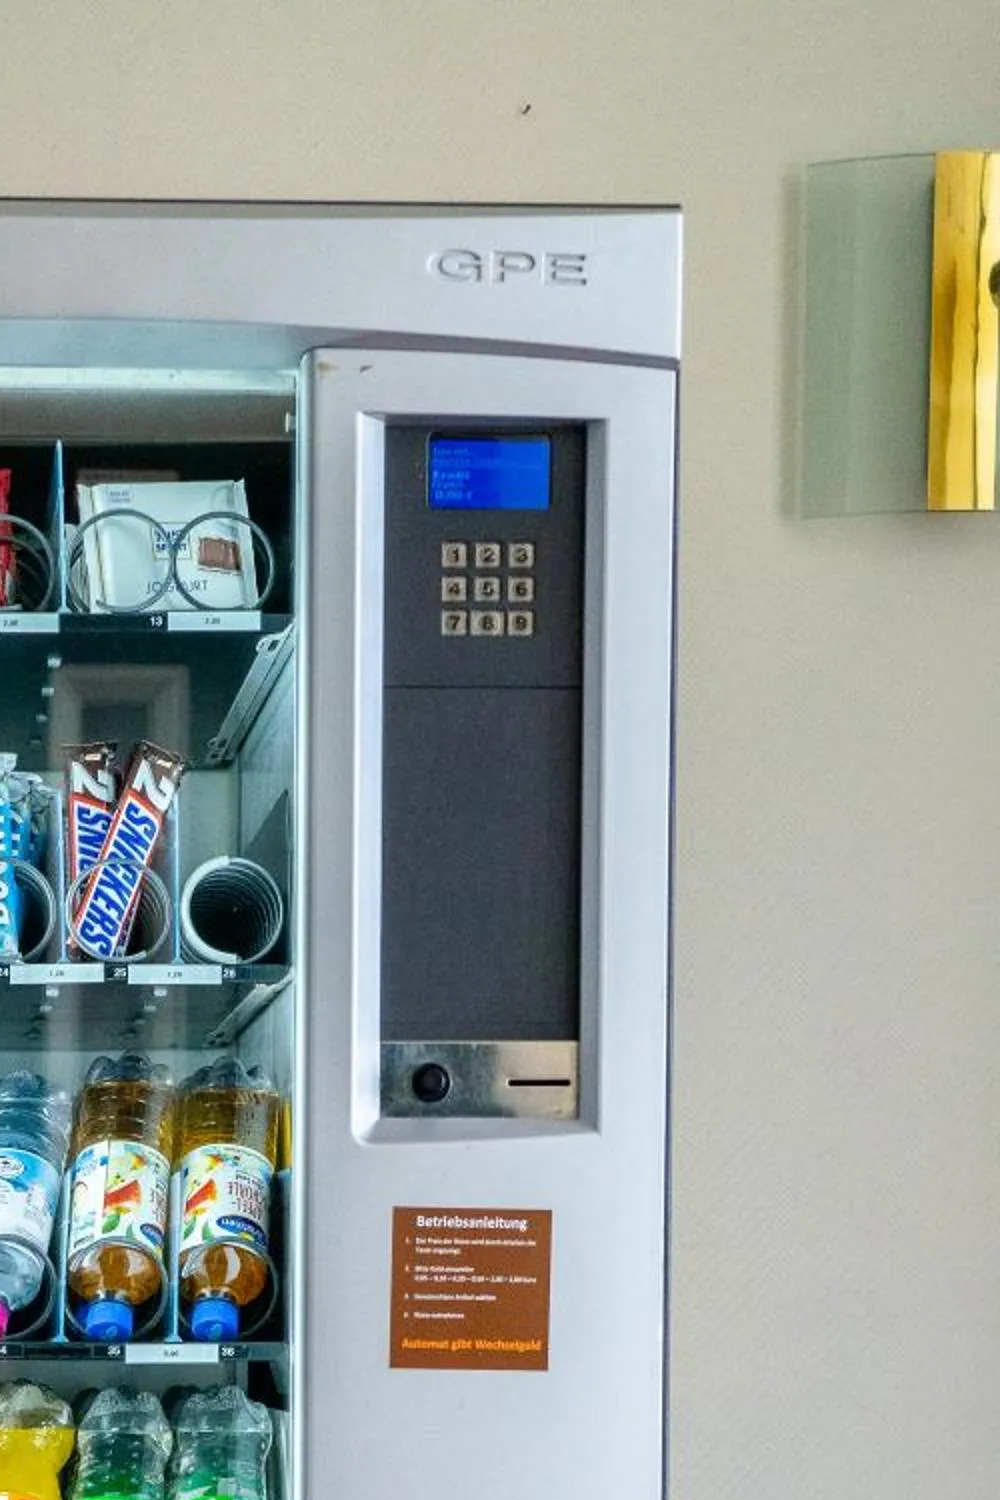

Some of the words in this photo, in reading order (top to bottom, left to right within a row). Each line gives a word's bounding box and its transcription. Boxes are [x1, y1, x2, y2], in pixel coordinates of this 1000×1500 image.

[427, 249, 588, 286] GPE
[150, 616, 163, 626] 13
[77, 805, 111, 873] SNIC
[79, 802, 159, 956] SNICKERS
[113, 968, 127, 977] 25
[416, 1216, 527, 1232] Betriebsanleitung
[401, 1338, 449, 1351] Automat
[451, 1338, 472, 1352] gibt
[474, 1338, 542, 1353] Wechselgeld
